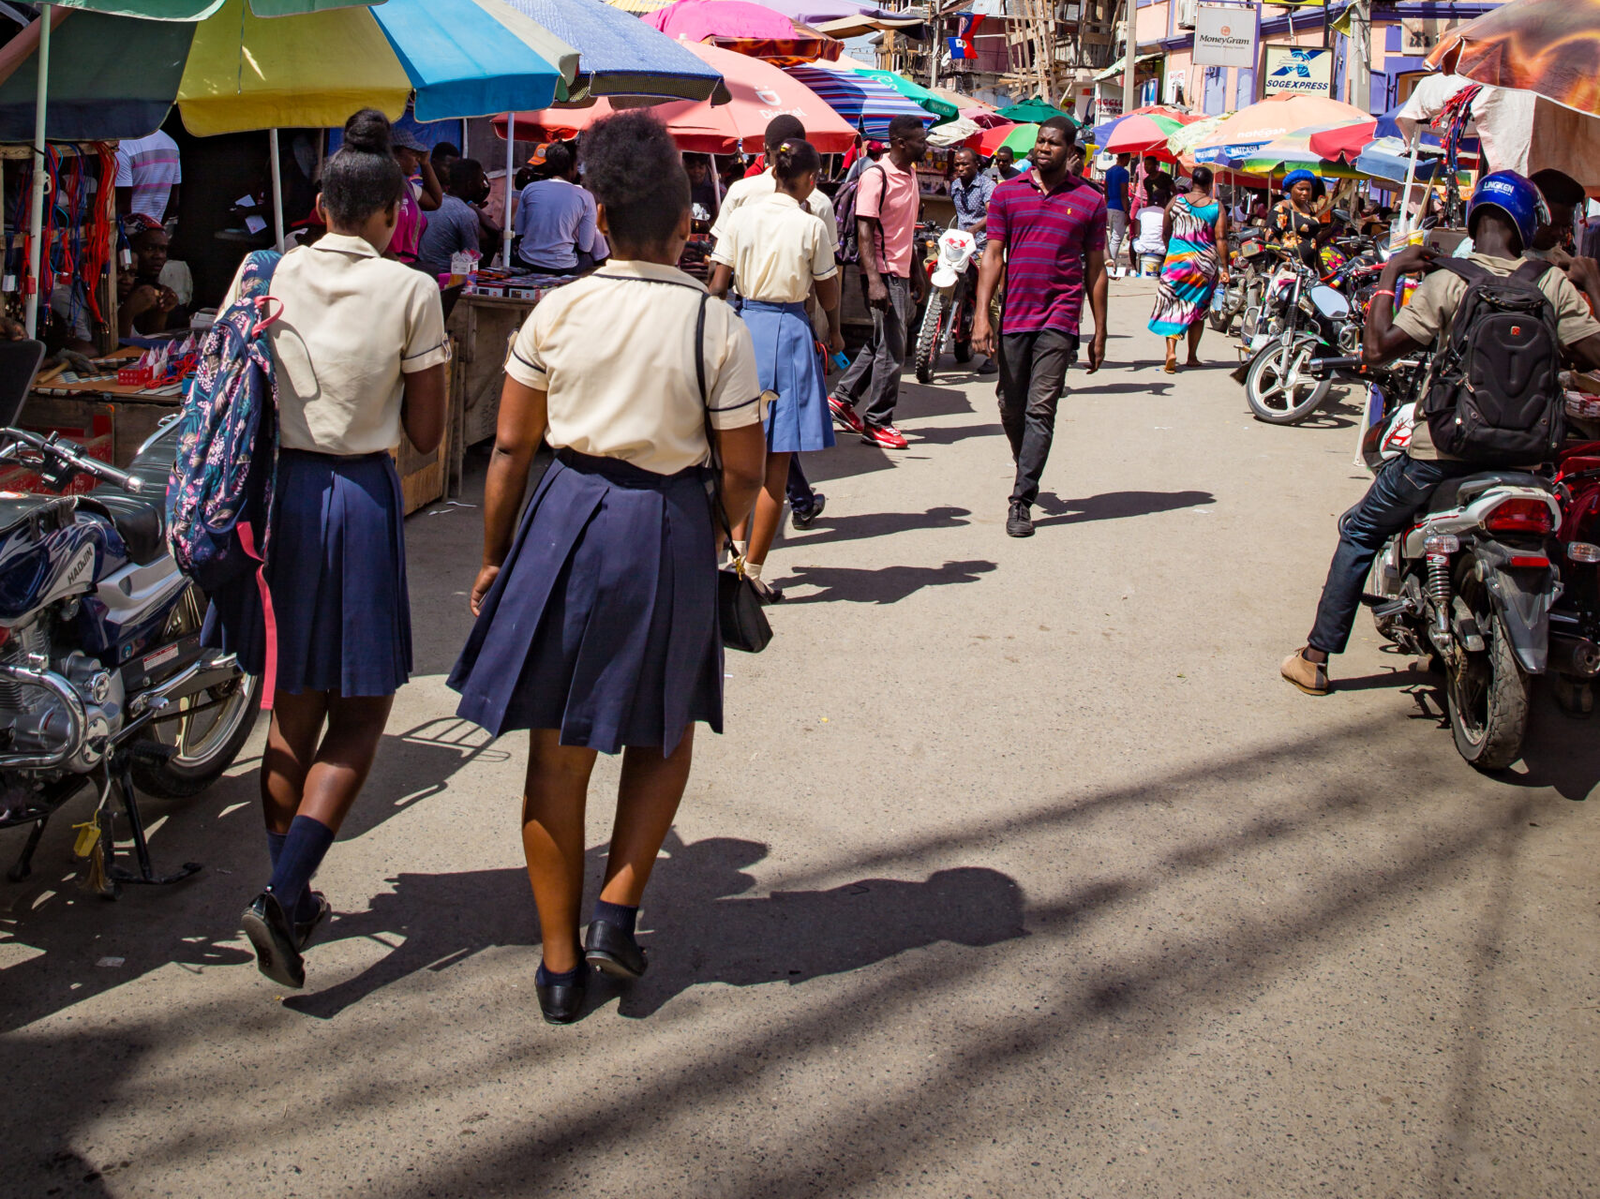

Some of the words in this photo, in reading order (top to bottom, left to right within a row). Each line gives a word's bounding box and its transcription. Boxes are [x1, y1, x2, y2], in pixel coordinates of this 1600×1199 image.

[1200, 35, 1250, 45] MoneyGram
[1266, 79, 1329, 90] SOGEXPRESS
[67, 546, 93, 584] HAOJIN
